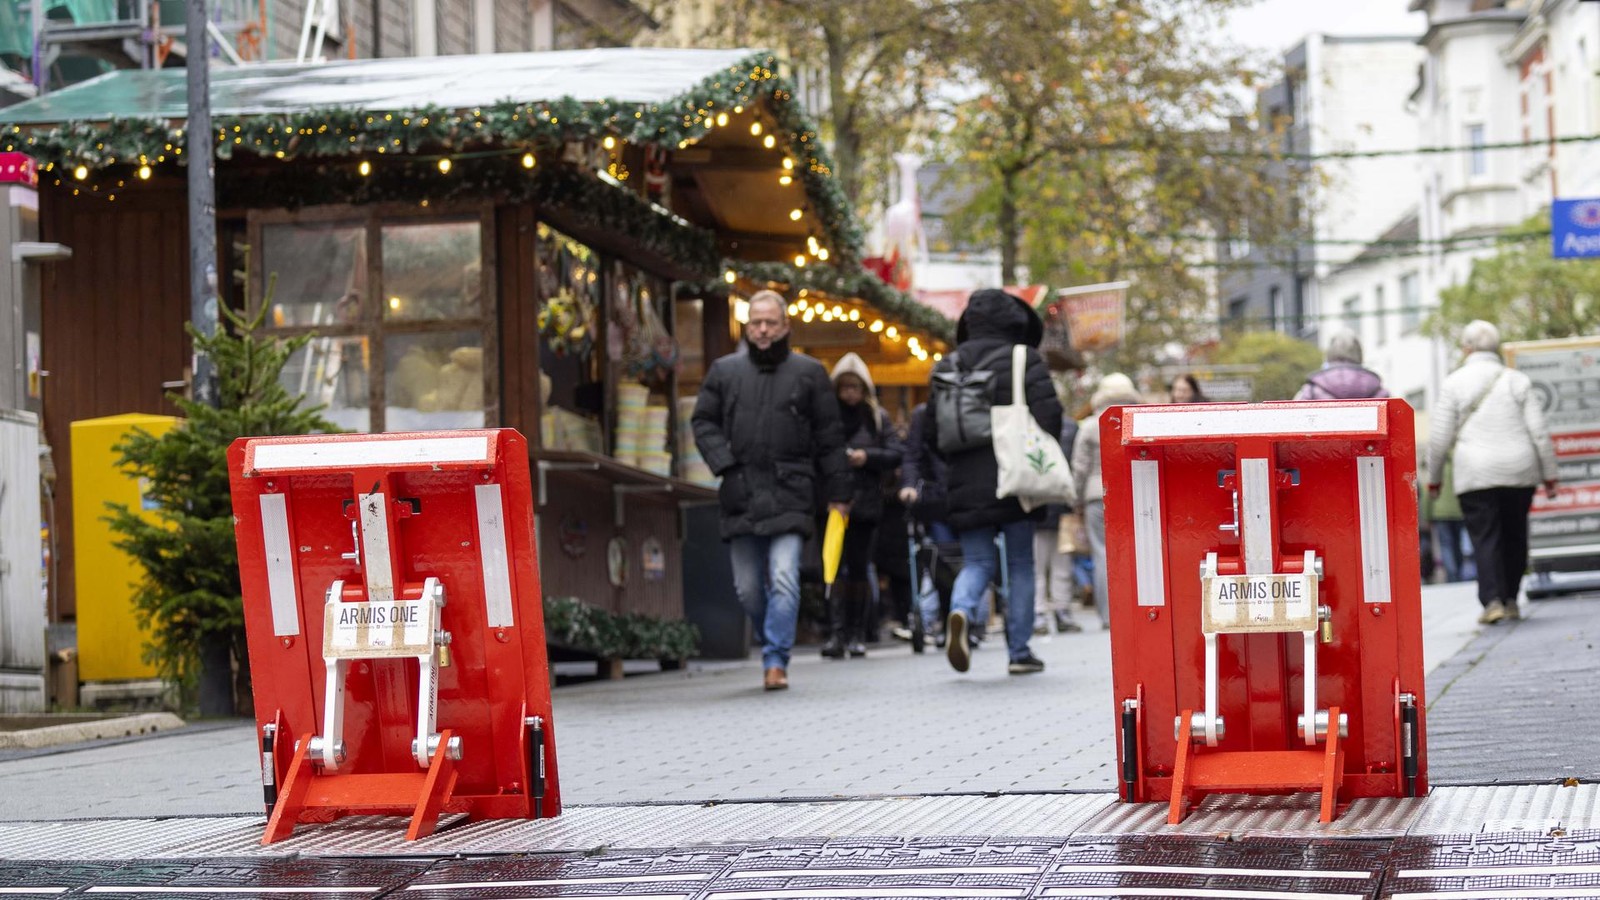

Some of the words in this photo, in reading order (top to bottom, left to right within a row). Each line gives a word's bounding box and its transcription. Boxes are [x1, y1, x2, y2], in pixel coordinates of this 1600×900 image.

[1218, 581, 1267, 600] ARMIS
[1271, 580, 1301, 599] ONE
[339, 606, 386, 625] ARMIS
[389, 605, 419, 623] ONE
